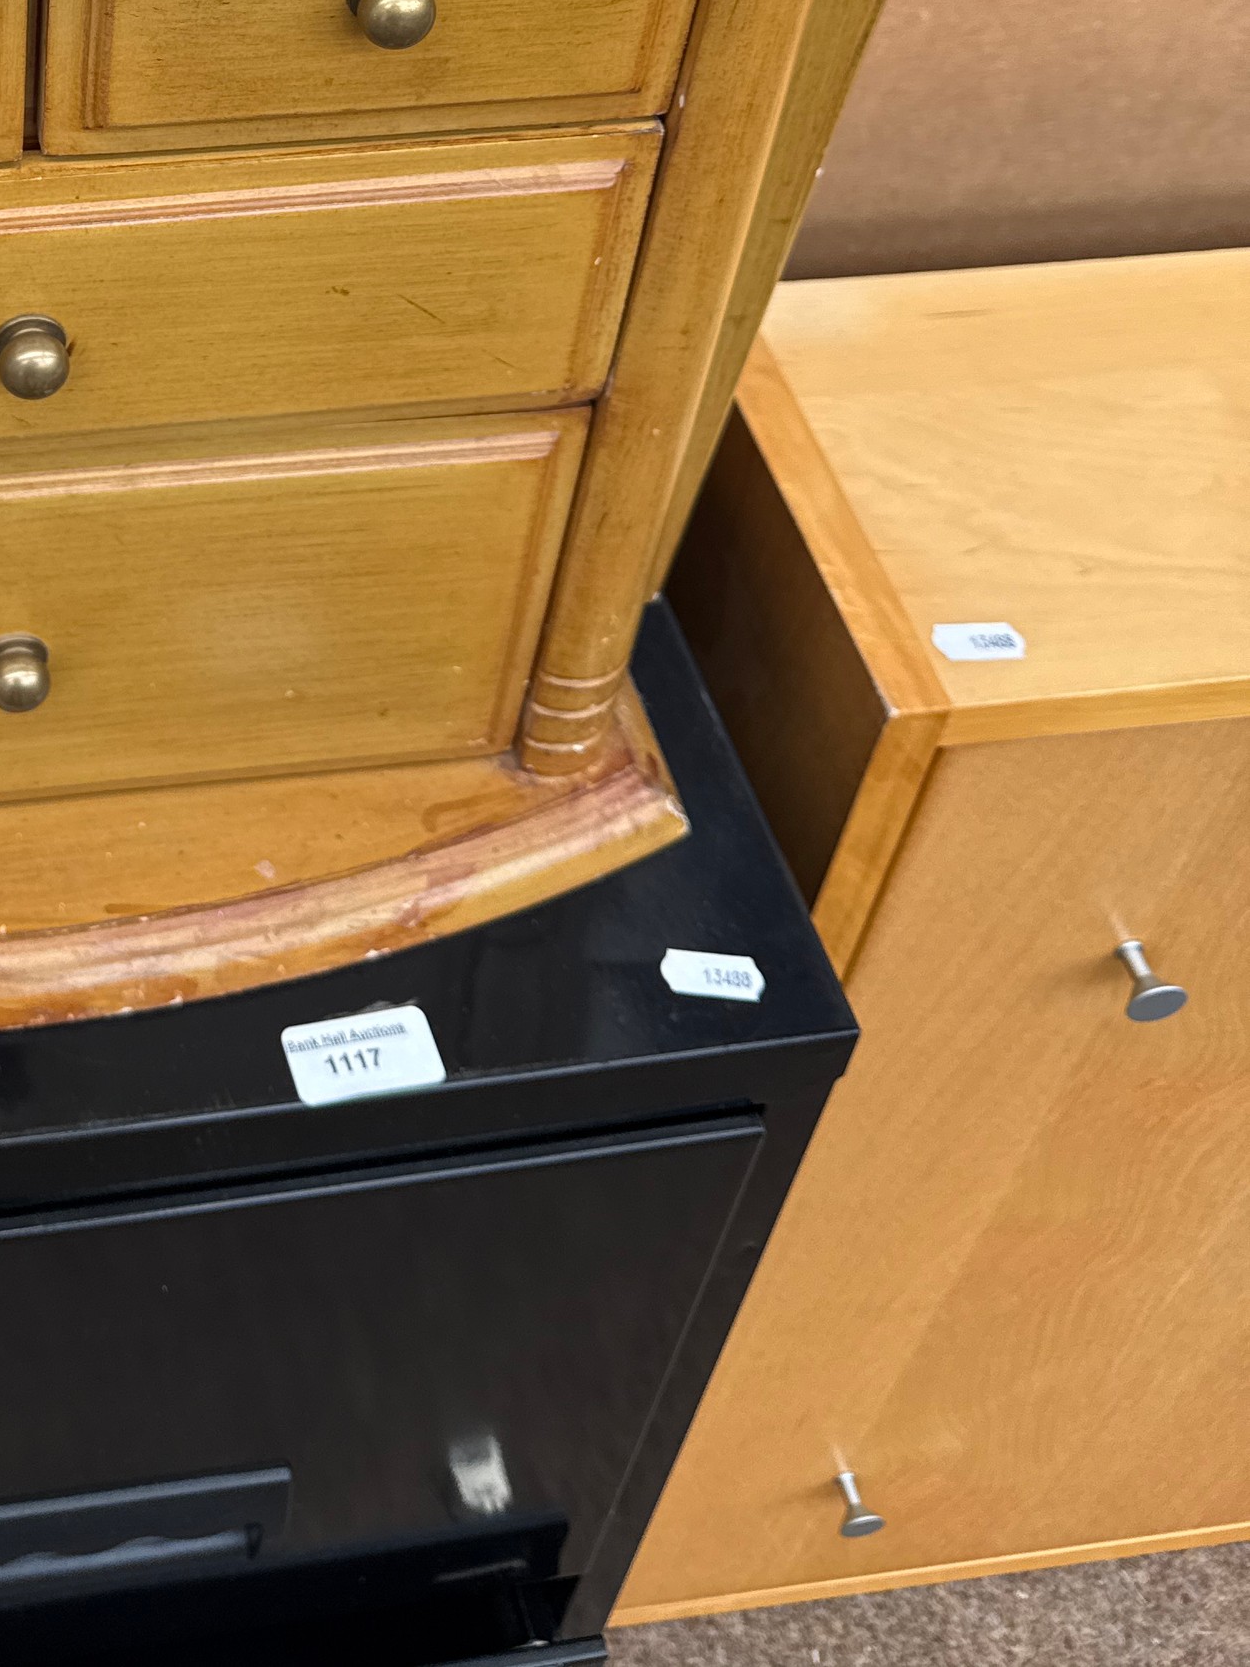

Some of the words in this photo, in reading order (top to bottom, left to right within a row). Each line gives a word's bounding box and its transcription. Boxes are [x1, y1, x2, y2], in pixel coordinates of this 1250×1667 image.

[286, 1036, 320, 1053] Bank
[321, 1031, 347, 1047] Hall
[349, 1022, 407, 1042] Auctions
[324, 1047, 382, 1074] 1117
